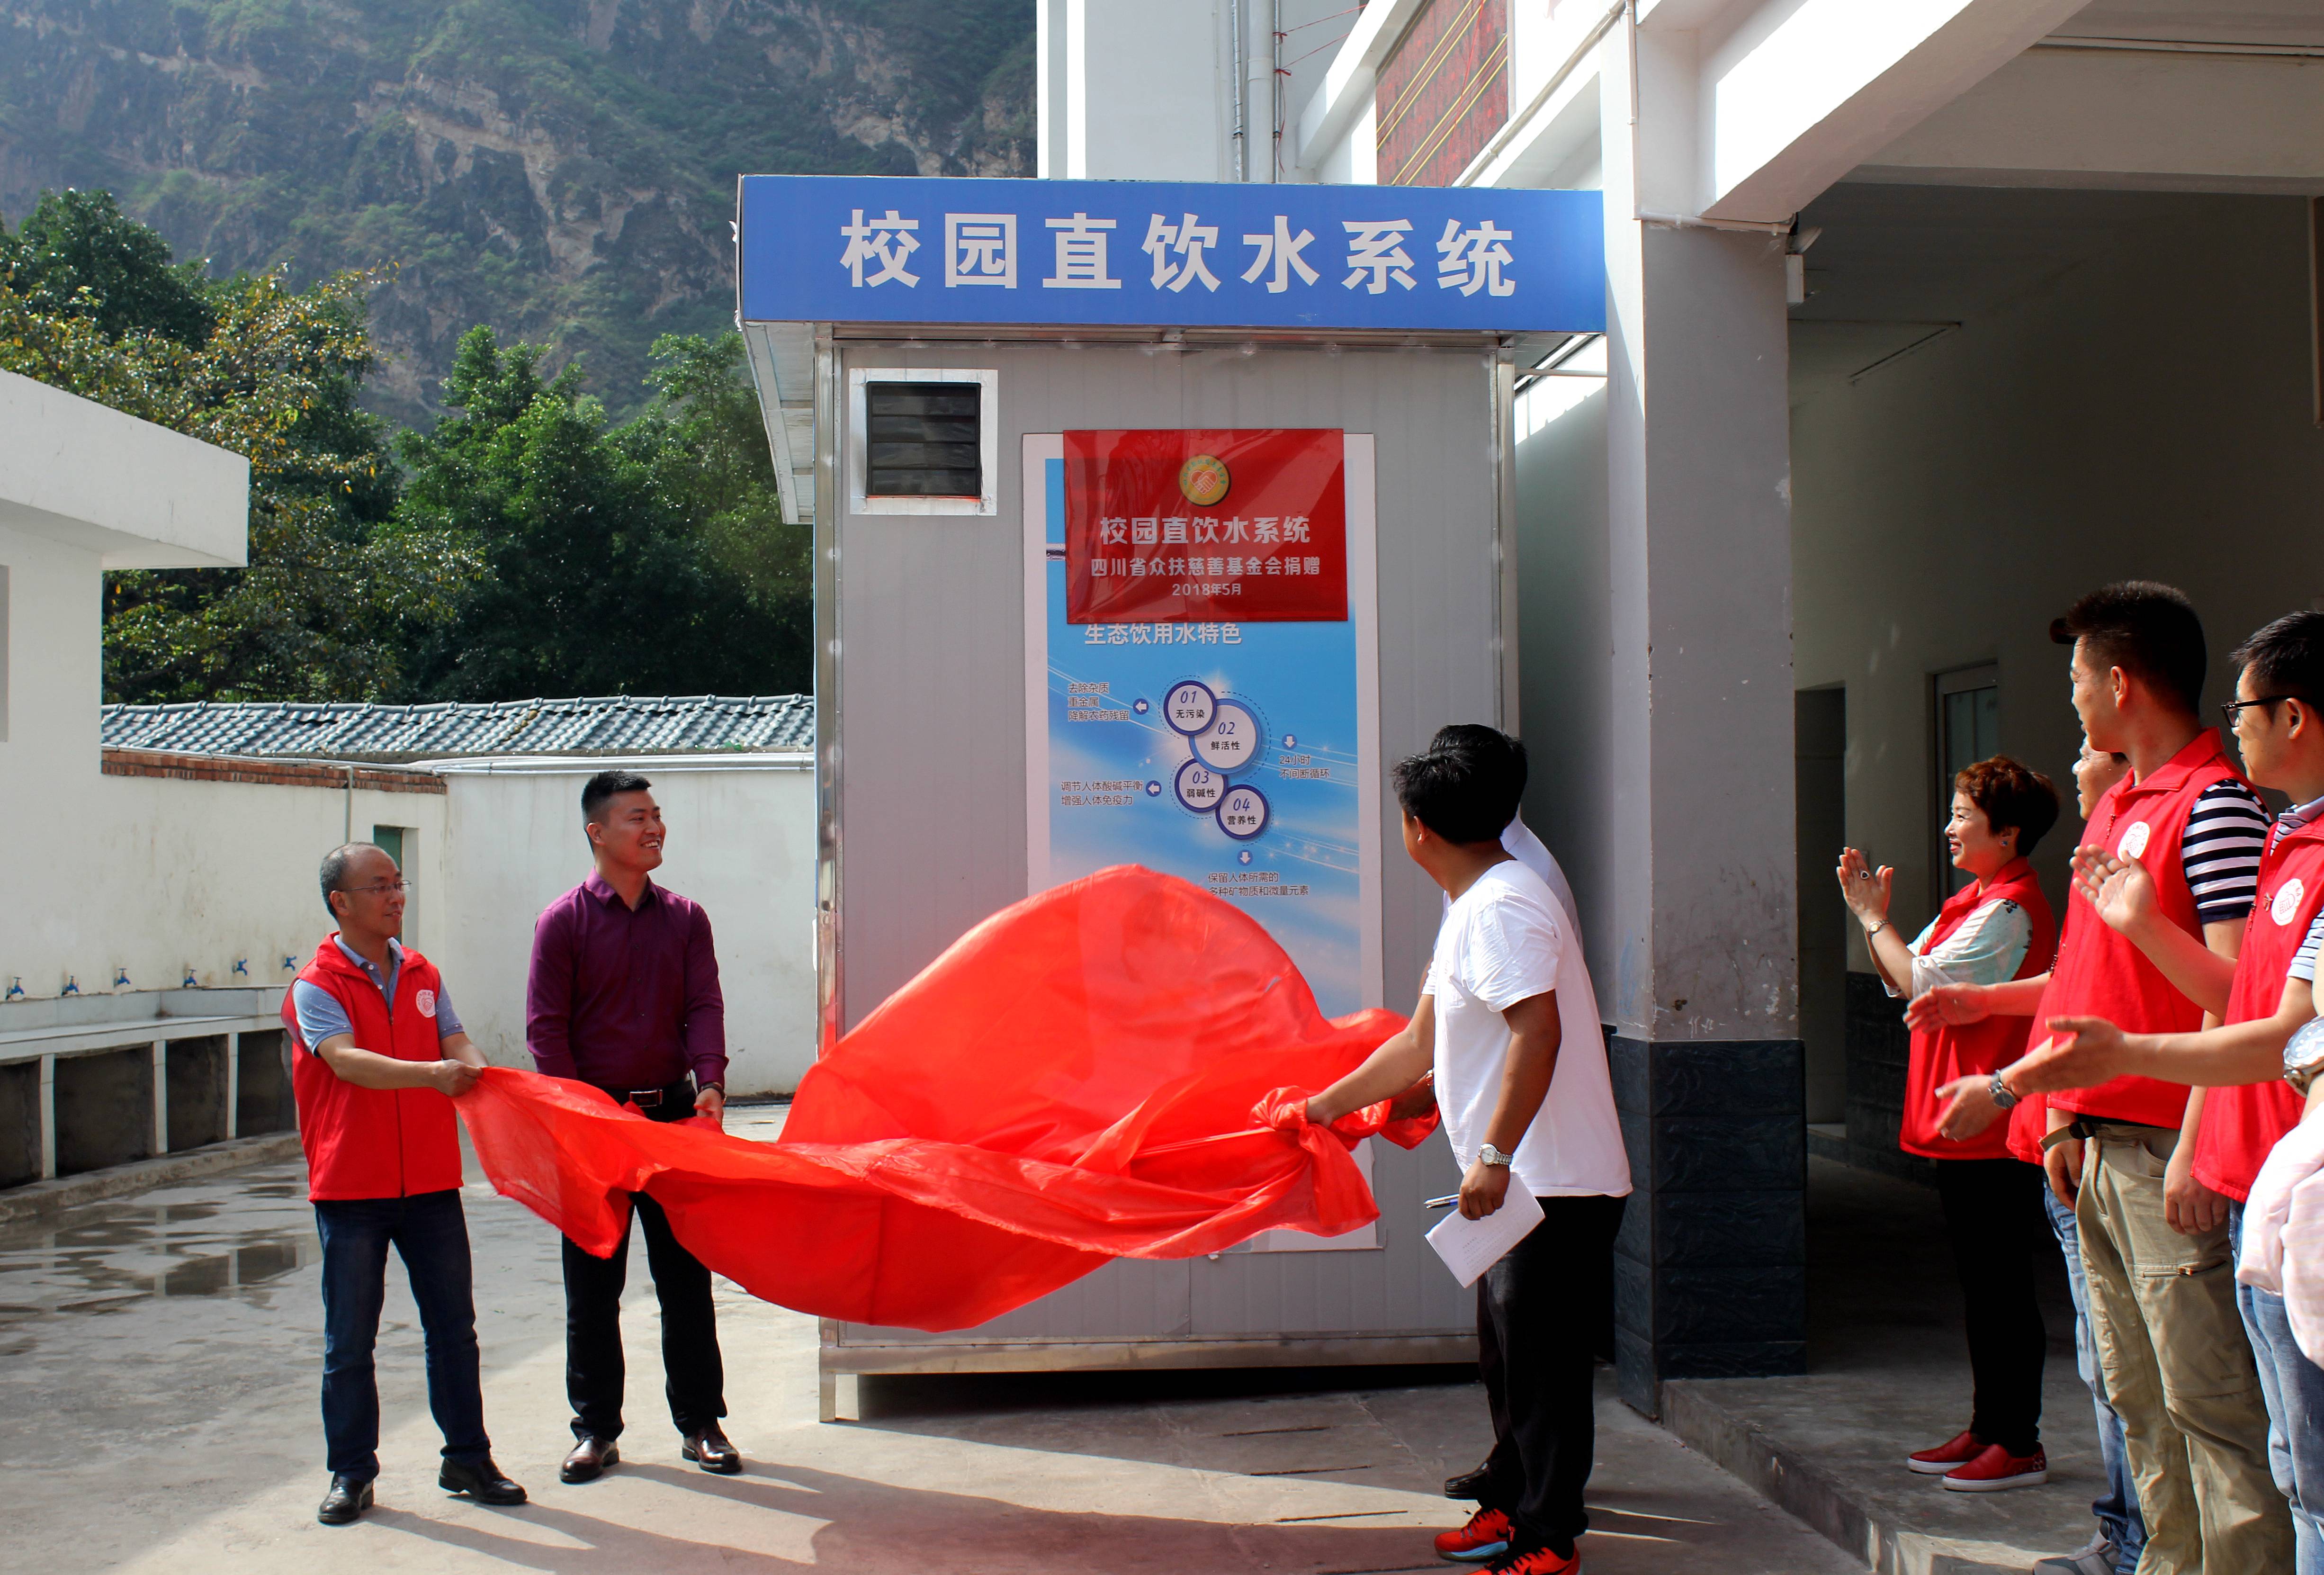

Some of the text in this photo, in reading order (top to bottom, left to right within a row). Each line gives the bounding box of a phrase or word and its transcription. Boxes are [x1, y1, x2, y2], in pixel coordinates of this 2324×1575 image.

[840, 209, 1516, 297] 校园直饮水系统
[1100, 516, 1310, 545] 校园直饮水系统
[1091, 557, 1320, 576] 四川省众扶慈善基金会捐赠
[1172, 583, 1241, 596] 2018年5月
[1084, 622, 1242, 645] 生态饮用水特色
[1068, 683, 1109, 693] 去除杂质
[1068, 696, 1099, 707] 重金属
[1180, 690, 1197, 703] 01
[1175, 709, 1205, 719] 无污染
[1218, 721, 1235, 735] 02
[1211, 741, 1240, 751] 鲜活性
[1279, 755, 1311, 765] 24小时
[1192, 771, 1209, 784] 03
[1280, 768, 1330, 779] 不间断循环
[1061, 781, 1143, 792] 调节人体酸碱平衡
[1186, 788, 1216, 798] 弱碱性
[1061, 795, 1133, 806] 增强人体免疫力
[1233, 798, 1250, 811] 04
[1227, 816, 1256, 825] 营养性
[1208, 872, 1279, 883] 保留人体所需的
[1208, 885, 1309, 897] 多种矿物质和微量元素
